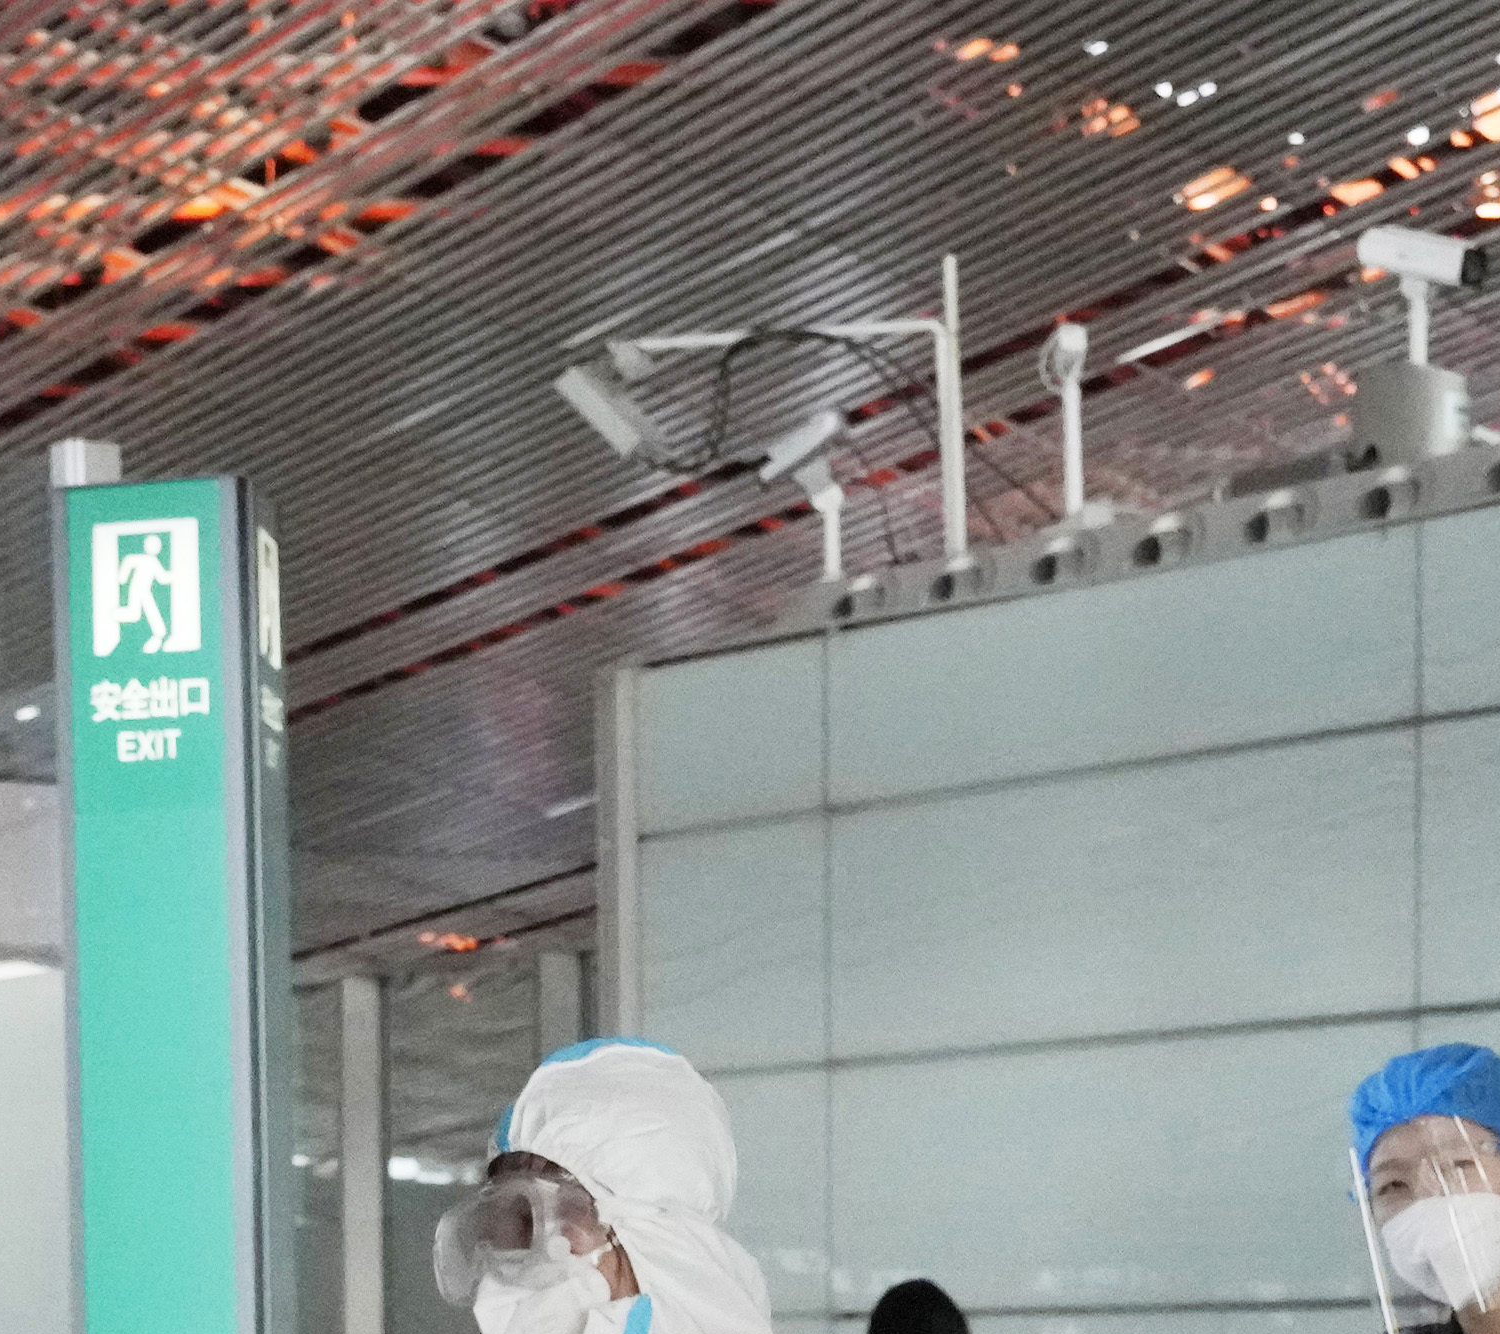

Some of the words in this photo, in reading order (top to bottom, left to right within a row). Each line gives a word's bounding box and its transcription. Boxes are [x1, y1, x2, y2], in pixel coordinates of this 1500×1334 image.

[89, 676, 211, 722] 安全出口
[116, 728, 182, 762] EXIT
